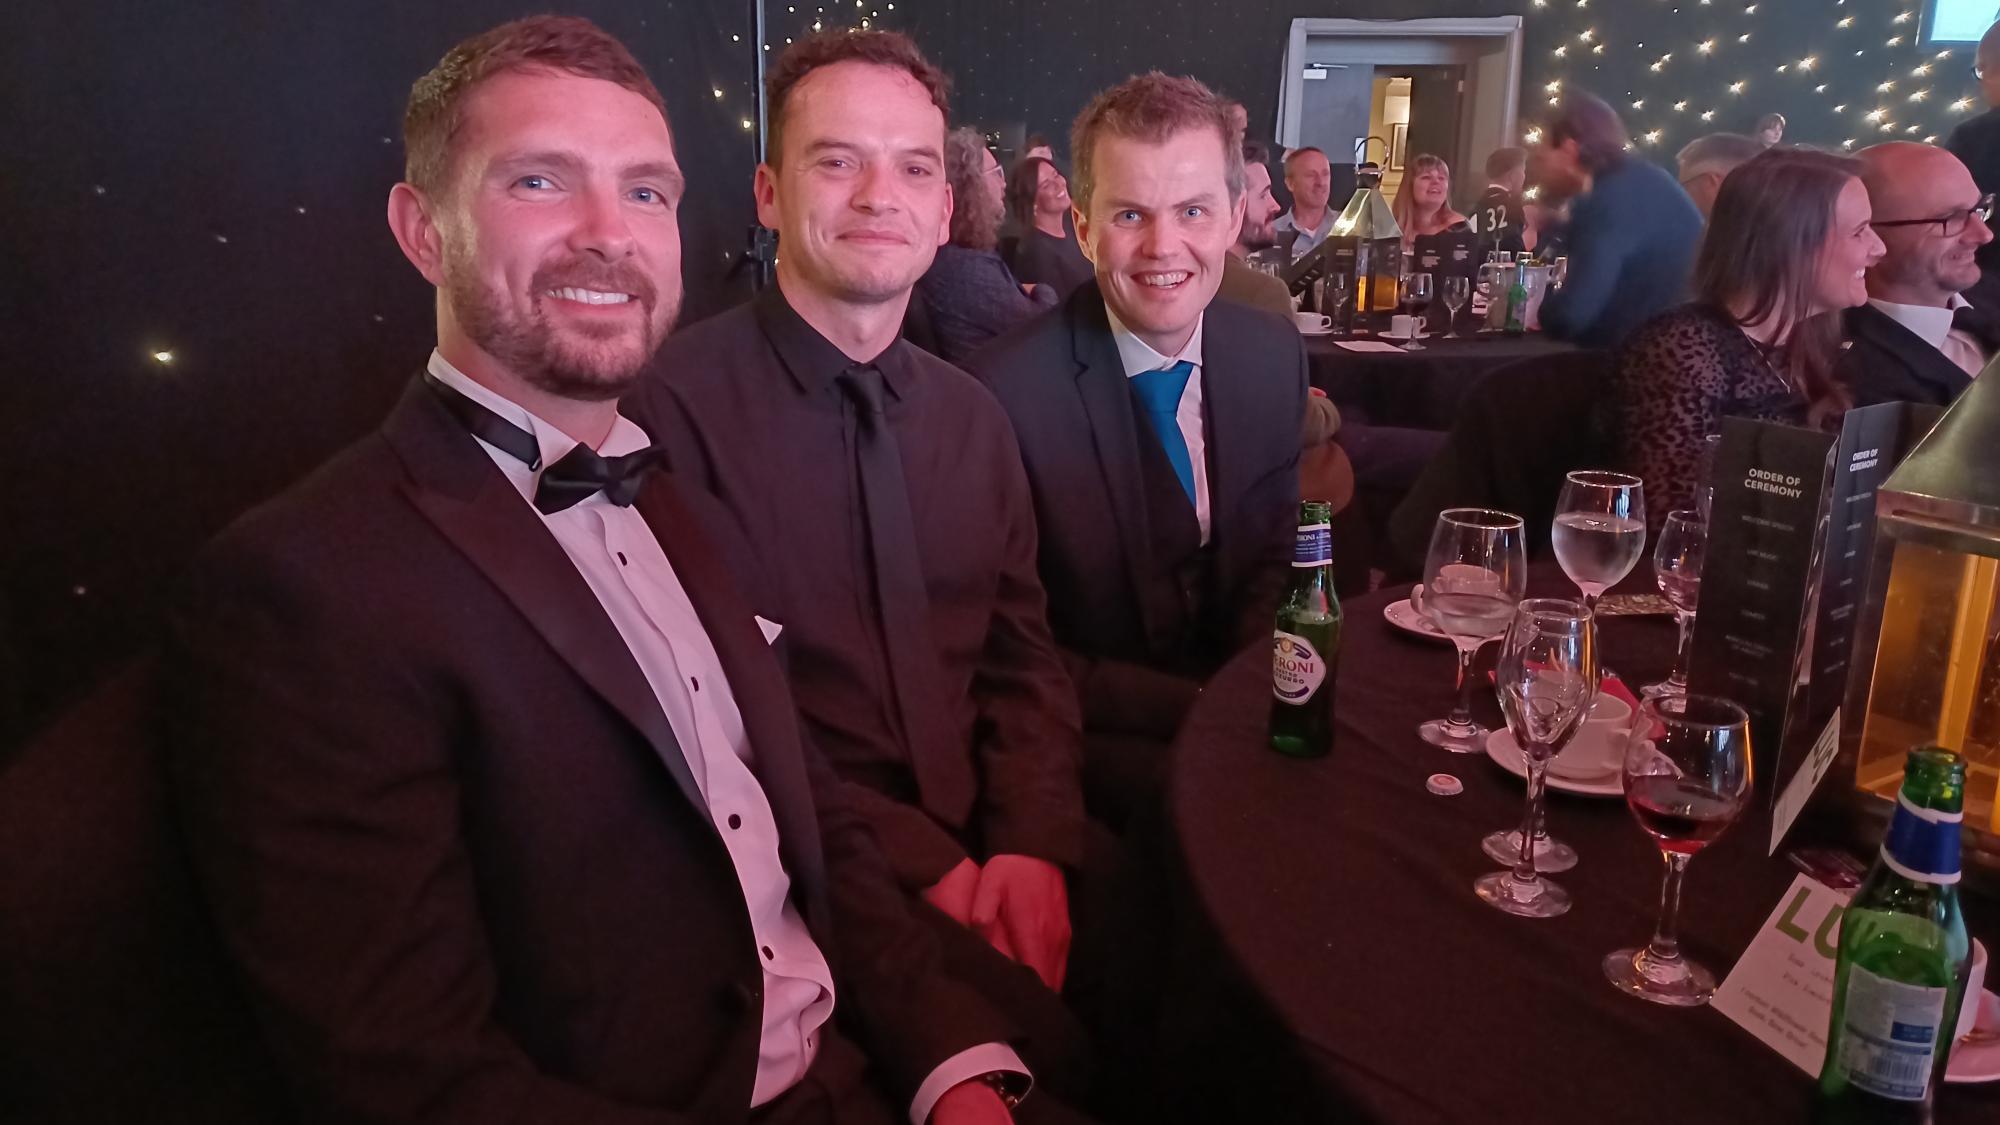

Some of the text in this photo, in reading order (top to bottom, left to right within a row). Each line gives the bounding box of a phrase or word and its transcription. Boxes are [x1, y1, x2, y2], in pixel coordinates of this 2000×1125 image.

[1487, 205, 1508, 232] 32
[1849, 458, 1878, 473] CEREMONY
[1748, 468, 1801, 486] ORDER OF
[1744, 479, 1802, 499] CEREMONY
[1275, 654, 1314, 674] ERONI
